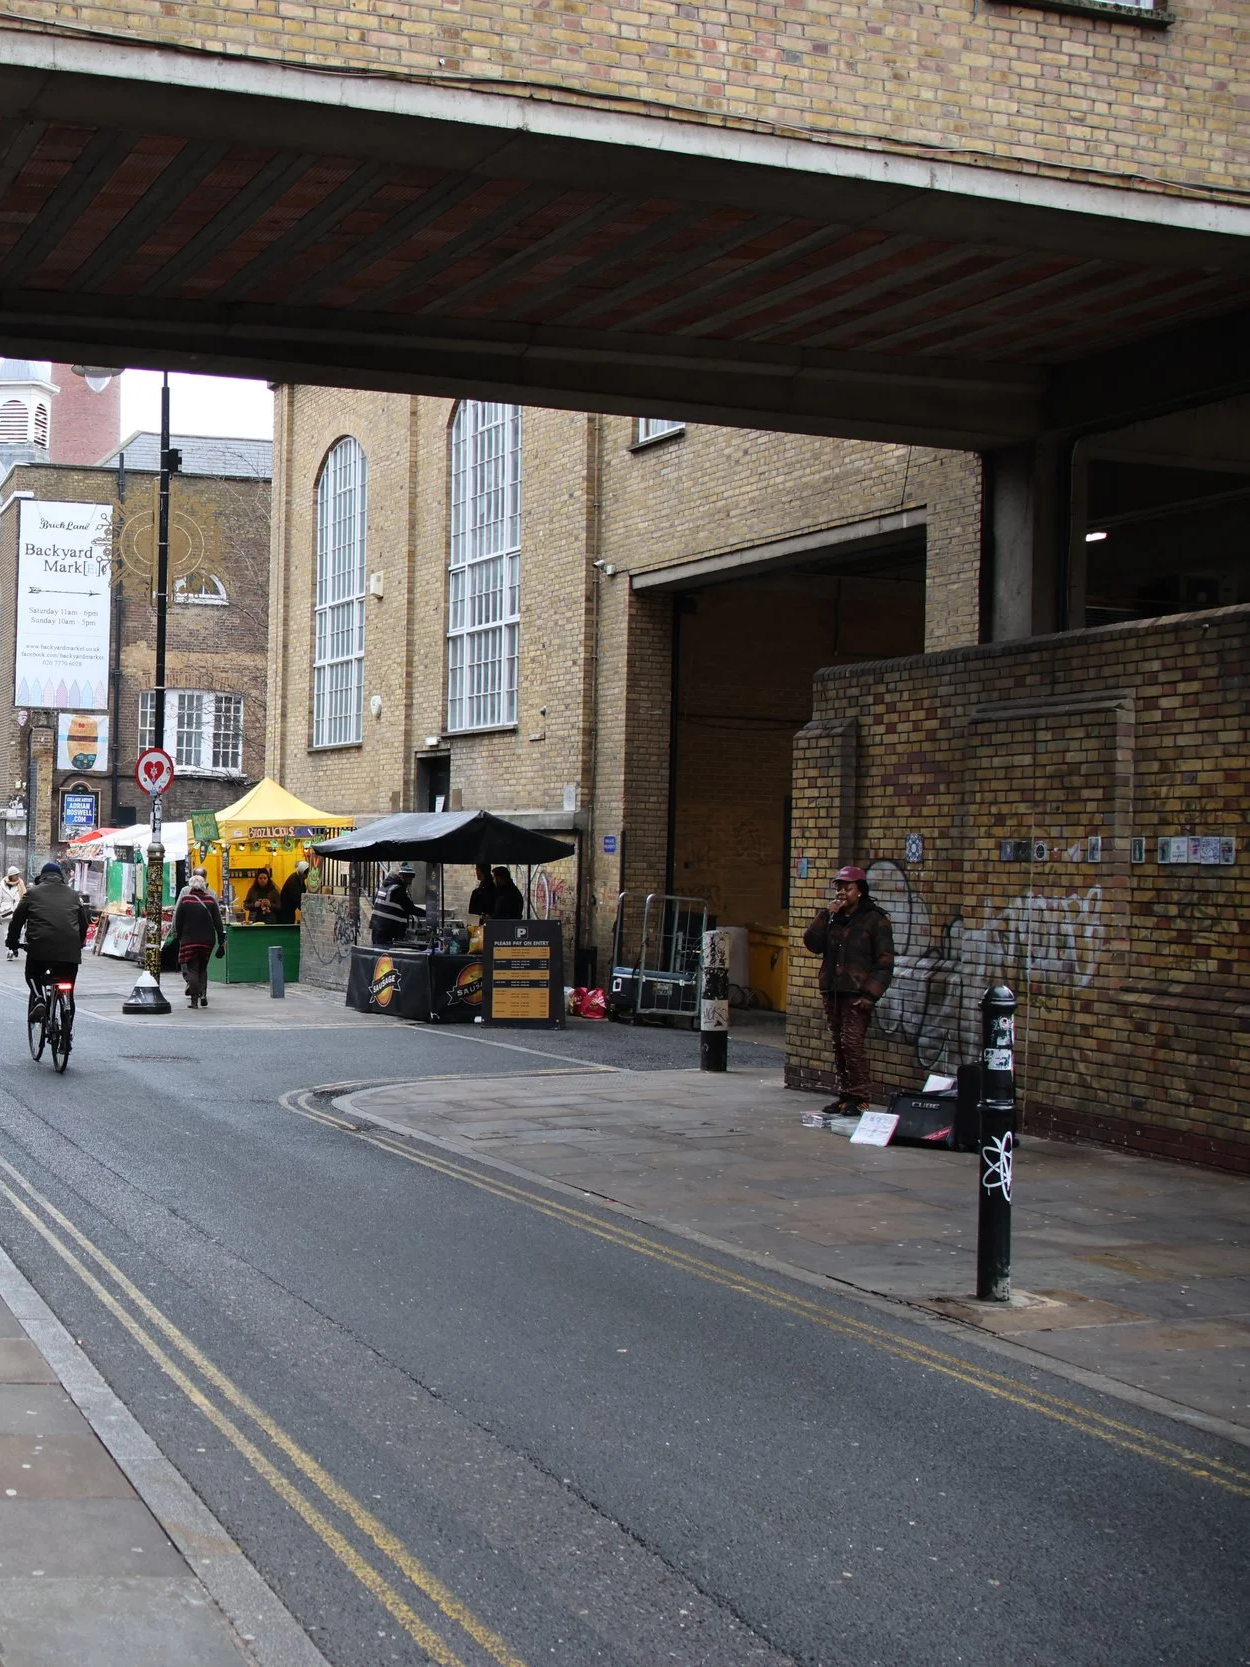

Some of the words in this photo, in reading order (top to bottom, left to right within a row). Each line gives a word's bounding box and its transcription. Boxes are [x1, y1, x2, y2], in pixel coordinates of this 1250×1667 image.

[65, 521, 90, 531] Lane
[25, 543, 93, 560] Backyard
[29, 607, 58, 616] Saturday
[60, 608, 78, 616] 11am
[83, 610, 98, 618] 6pm
[30, 617, 56, 625] Sunday
[81, 619, 96, 627] 5pm
[516, 928, 527, 938] P
[372, 974, 396, 993] SAUSAGE
[911, 1101, 941, 1110] CUBE
